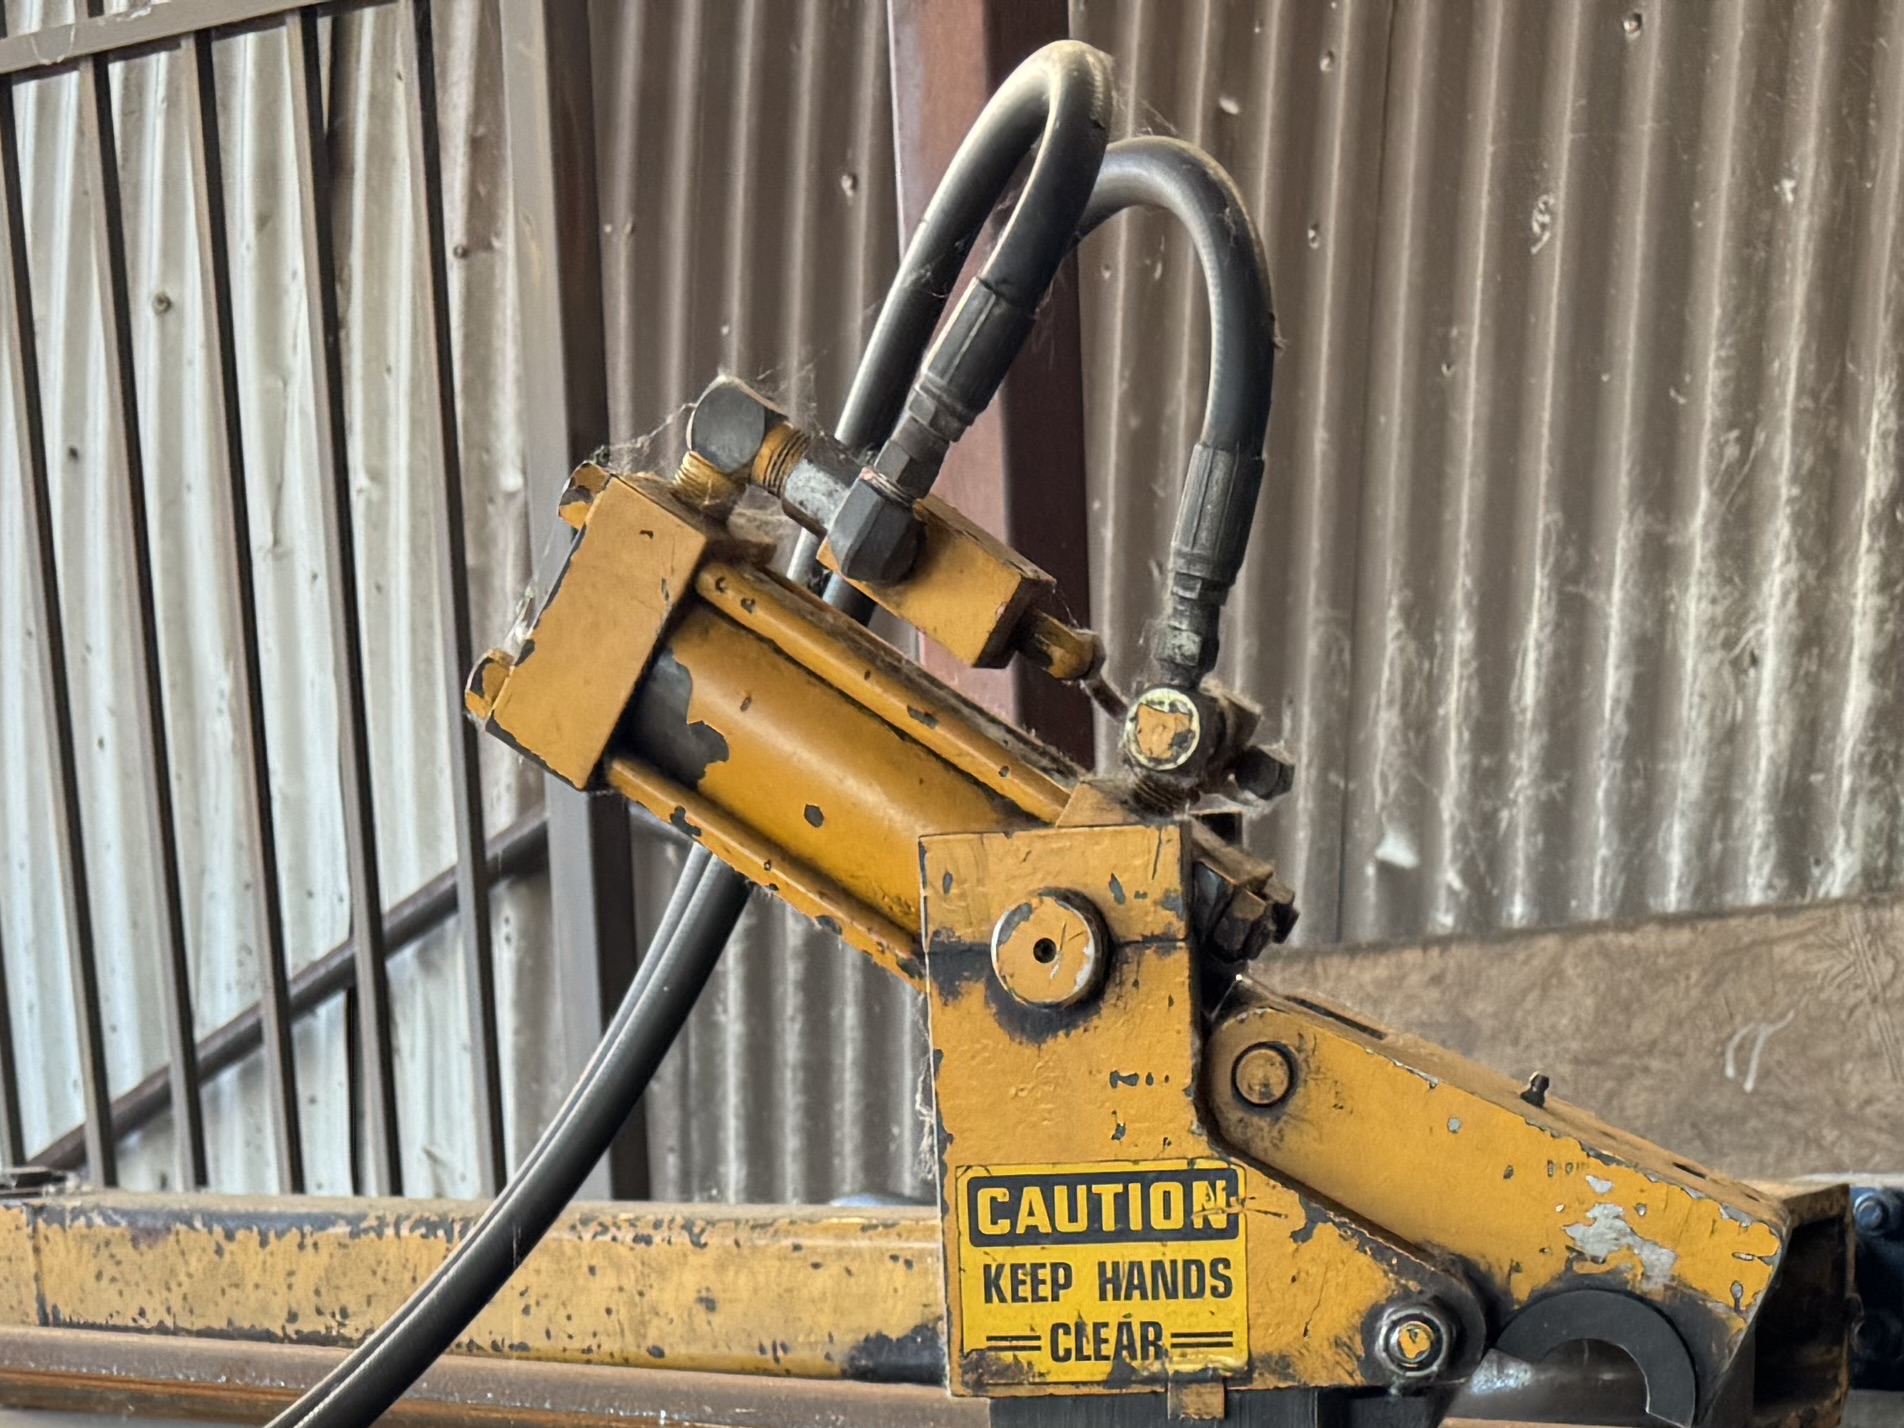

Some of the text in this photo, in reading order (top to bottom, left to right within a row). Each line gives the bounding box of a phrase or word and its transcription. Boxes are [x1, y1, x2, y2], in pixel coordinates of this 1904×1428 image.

[977, 1180, 1227, 1235] CAUTION
[983, 1257, 1233, 1304] KEEP HANDS
[1050, 1321, 1166, 1363] CLEAR
